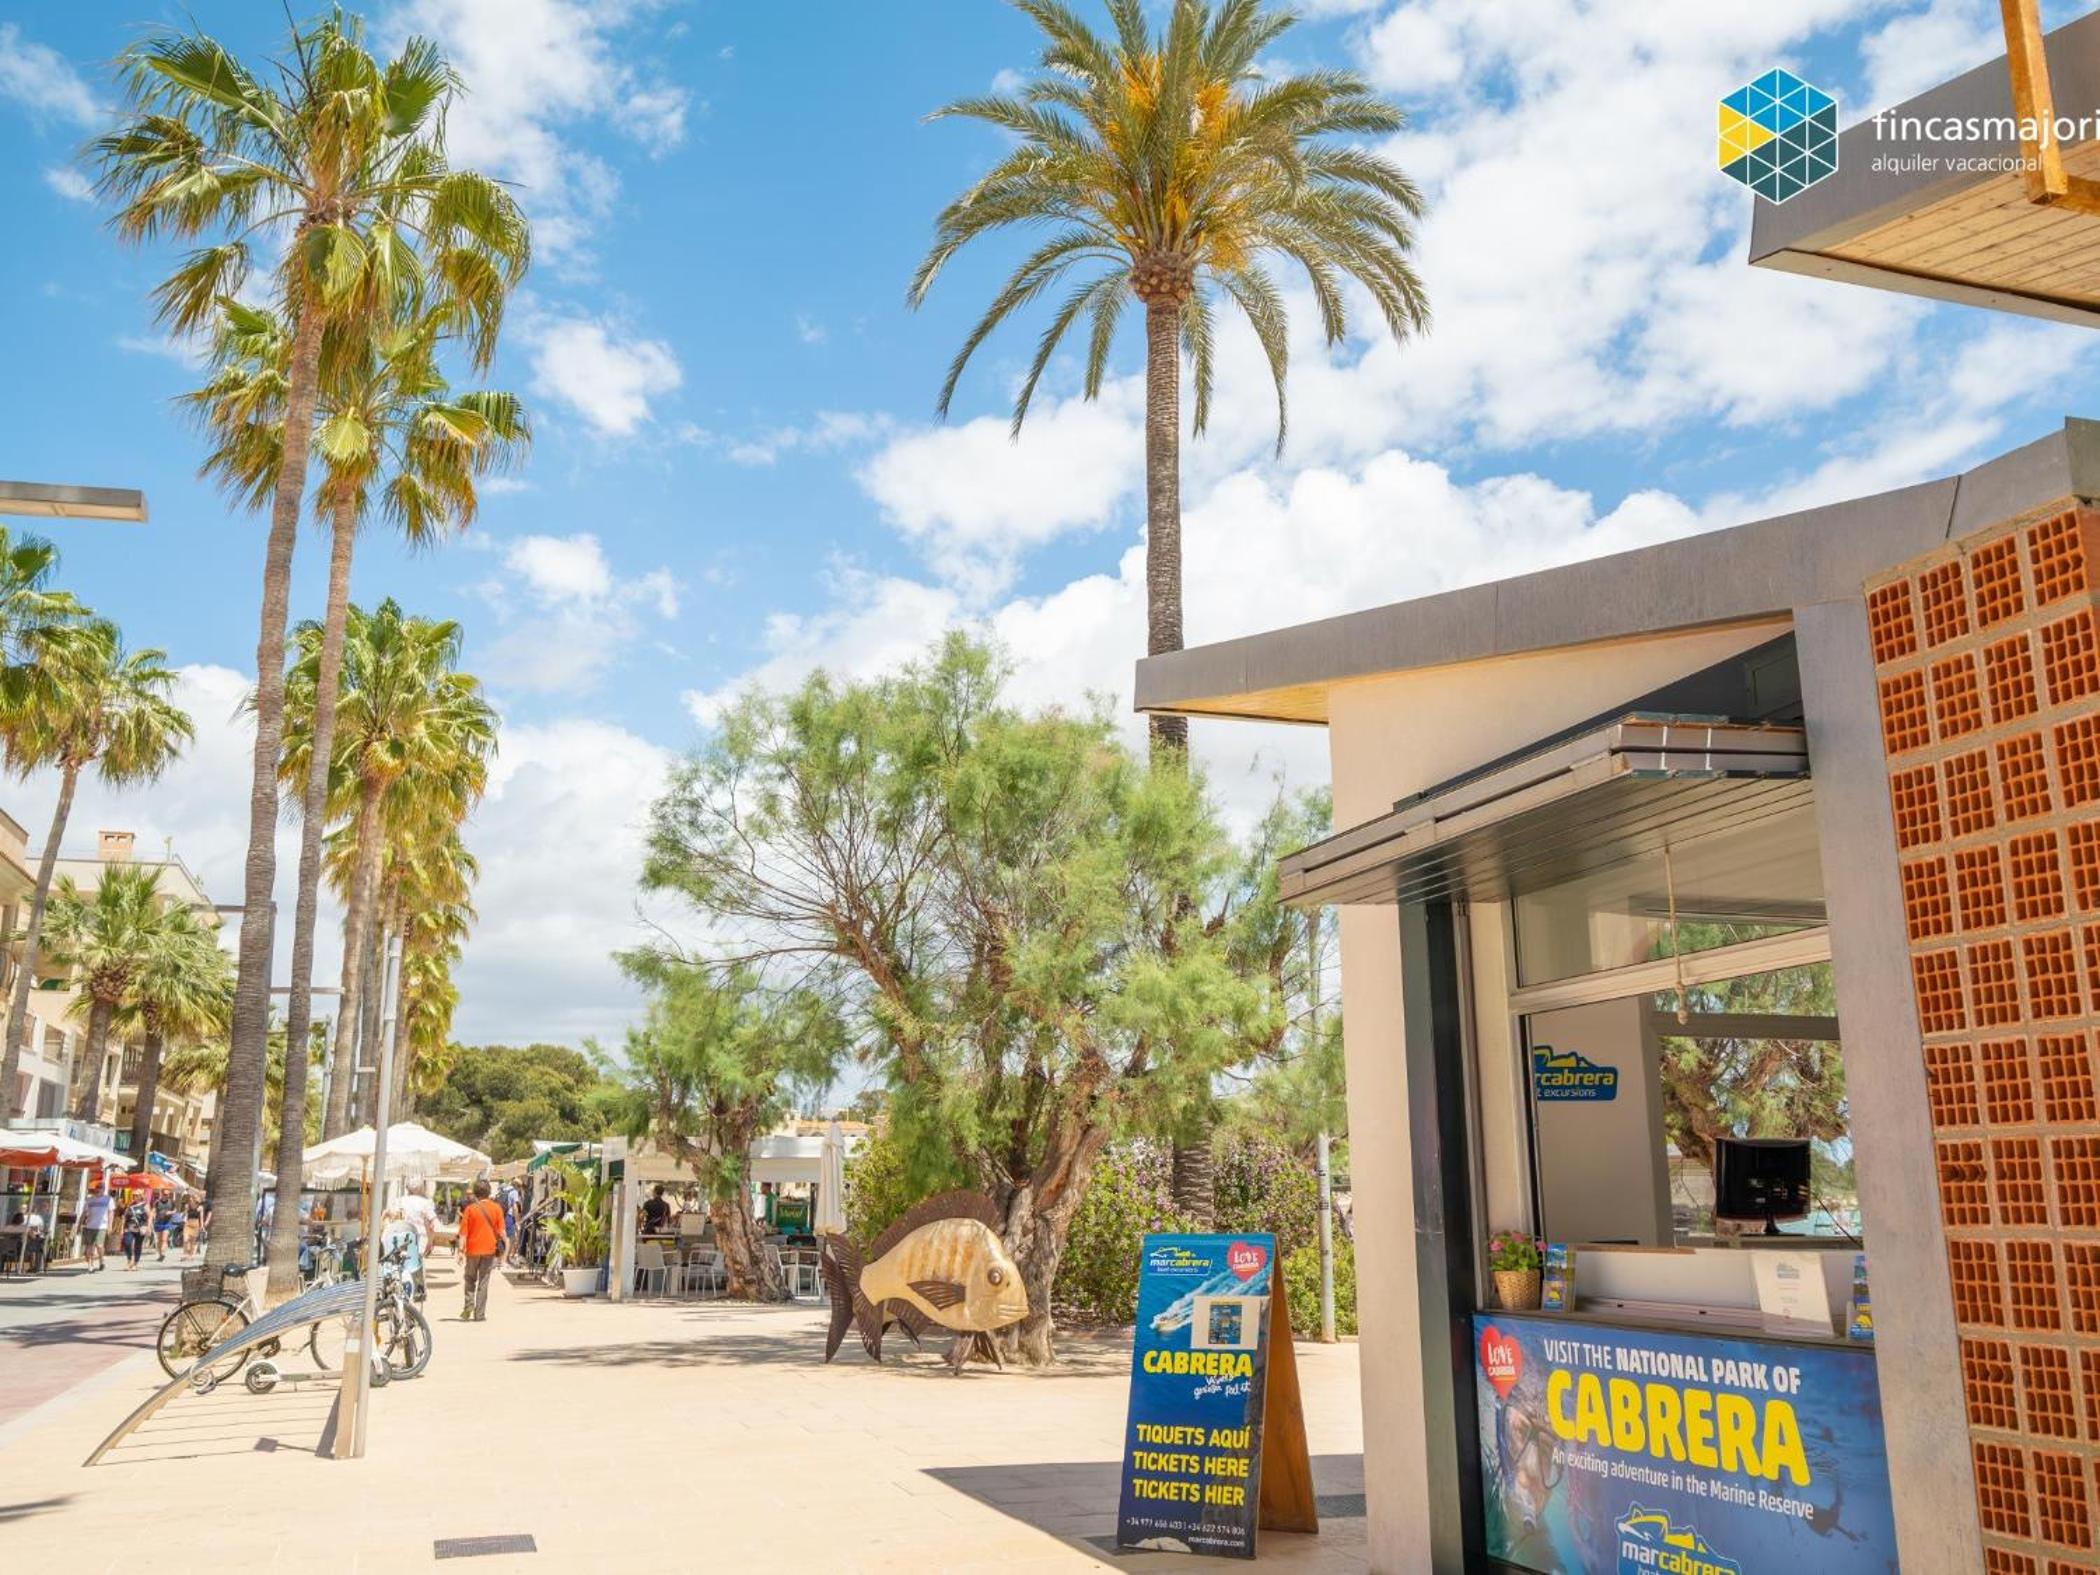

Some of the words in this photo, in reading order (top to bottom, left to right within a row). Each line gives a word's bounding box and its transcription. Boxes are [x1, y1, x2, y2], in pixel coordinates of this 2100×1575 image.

[1143, 1350, 1253, 1377] CABRERA
[1487, 1343, 1513, 1365] LOVE
[1543, 1339, 1580, 1365] VISIT
[1583, 1343, 1612, 1370] THE
[1615, 1347, 1708, 1382] NATIONAL
[1712, 1357, 1769, 1391] PARK
[1773, 1364, 1801, 1394] OF
[1136, 1424, 1205, 1446] TIQUETS
[1209, 1425, 1251, 1449] AQUÍ
[1546, 1369, 1811, 1486] CABRERA
[1133, 1451, 1200, 1474] TICKETS
[1204, 1455, 1250, 1478] HERE
[1133, 1478, 1201, 1503] TICKETS
[1204, 1484, 1245, 1507] HIER
[1551, 1447, 1565, 1465] An
[1567, 1451, 1609, 1477] exciting
[1611, 1460, 1669, 1488] adventure
[1671, 1470, 1683, 1491] in
[1686, 1474, 1708, 1497] the
[1711, 1480, 1755, 1507] Marine
[1759, 1489, 1814, 1520] Reserve
